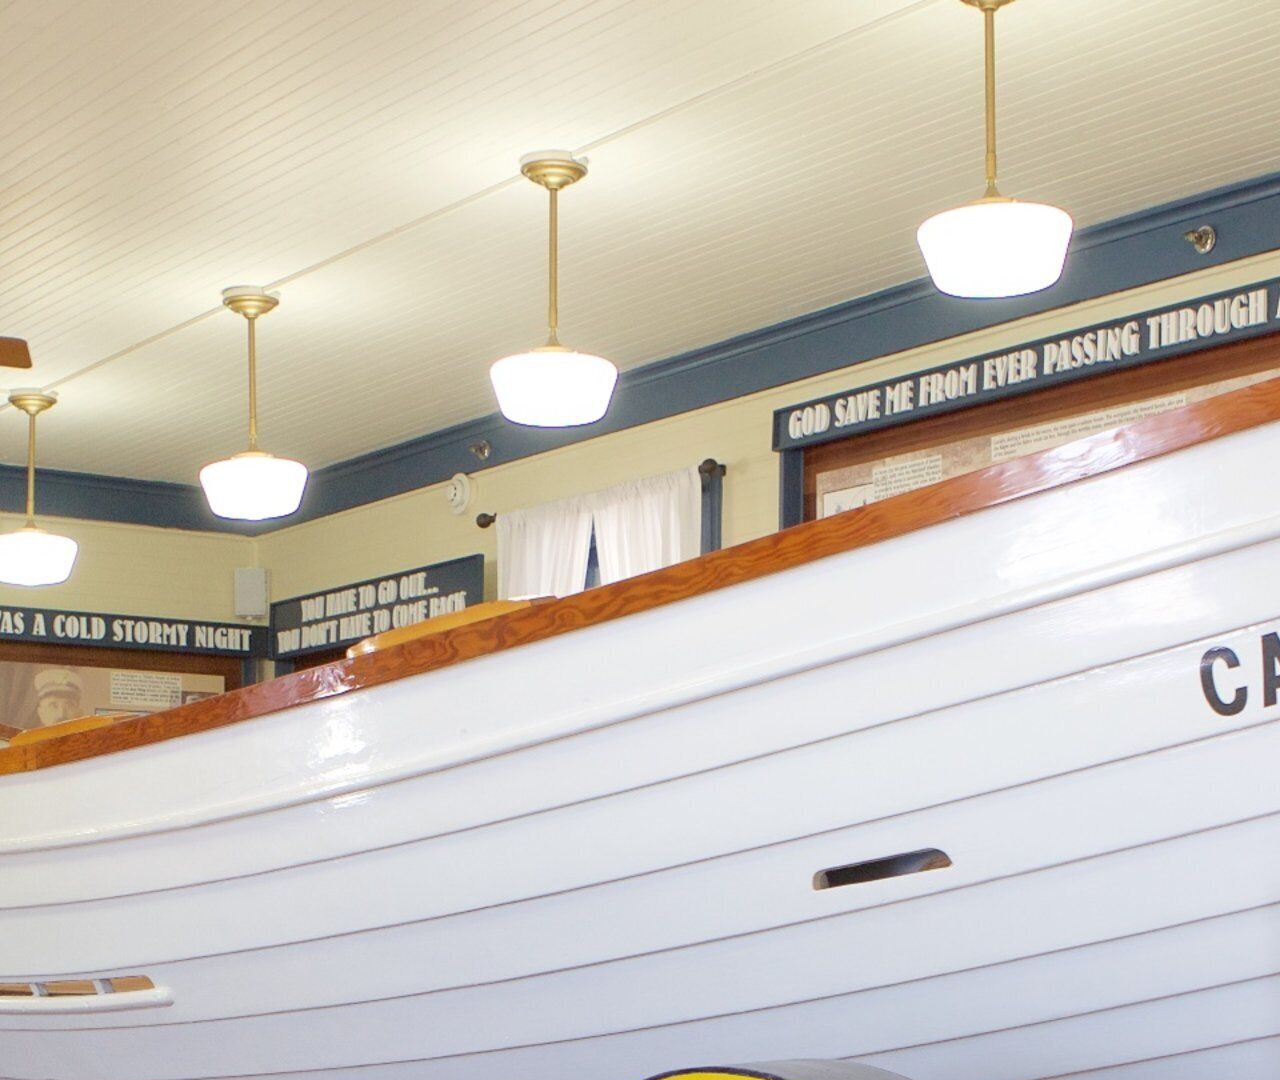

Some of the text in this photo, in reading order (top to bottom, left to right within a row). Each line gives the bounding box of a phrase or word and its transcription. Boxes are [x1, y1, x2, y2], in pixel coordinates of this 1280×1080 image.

[788, 402, 831, 440] GOD
[834, 388, 881, 428] SAVE
[885, 380, 914, 416] ME
[919, 363, 977, 407] FROM
[983, 348, 1038, 391] EVER
[1043, 320, 1140, 376] PASSING
[1146, 287, 1268, 350] THROUGH
[277, 589, 468, 655] YOU DON'T HAVE TO COME BACK
[300, 595, 324, 623] YOU
[325, 587, 358, 617] HAVE
[359, 583, 377, 611] TO
[377, 579, 399, 605] GO
[31, 612, 47, 637] A
[53, 614, 106, 641] COLD
[112, 619, 189, 648] STORMY
[194, 623, 253, 652] NIGHT
